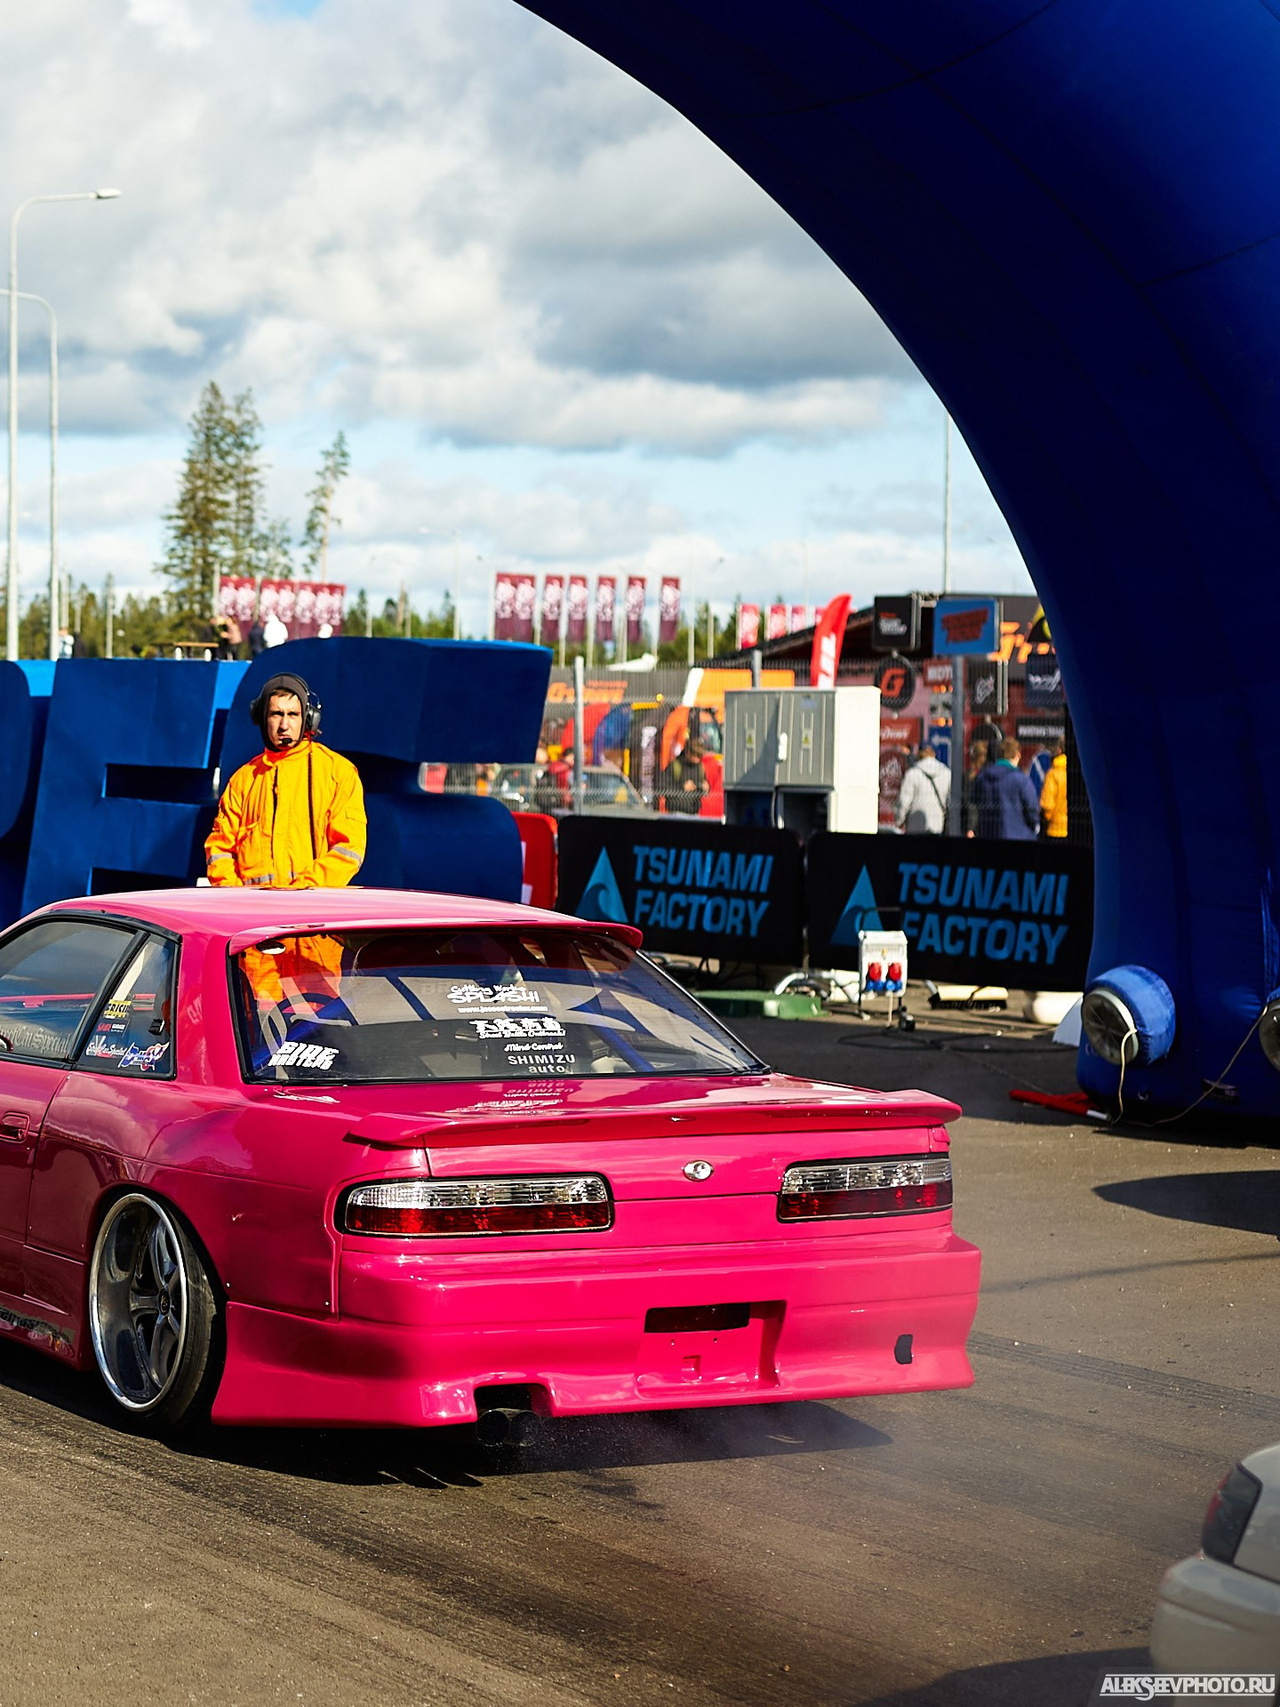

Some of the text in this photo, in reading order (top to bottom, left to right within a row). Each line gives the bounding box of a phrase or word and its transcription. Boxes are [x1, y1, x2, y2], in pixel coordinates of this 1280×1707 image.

[633, 845, 774, 893] TSUNAMI
[898, 863, 1068, 916] TSUNAMI
[634, 889, 769, 937] FACTORY
[903, 911, 1068, 965] FACTORY
[507, 1054, 576, 1065] SHIMIZU
[528, 1064, 566, 1073] auto
